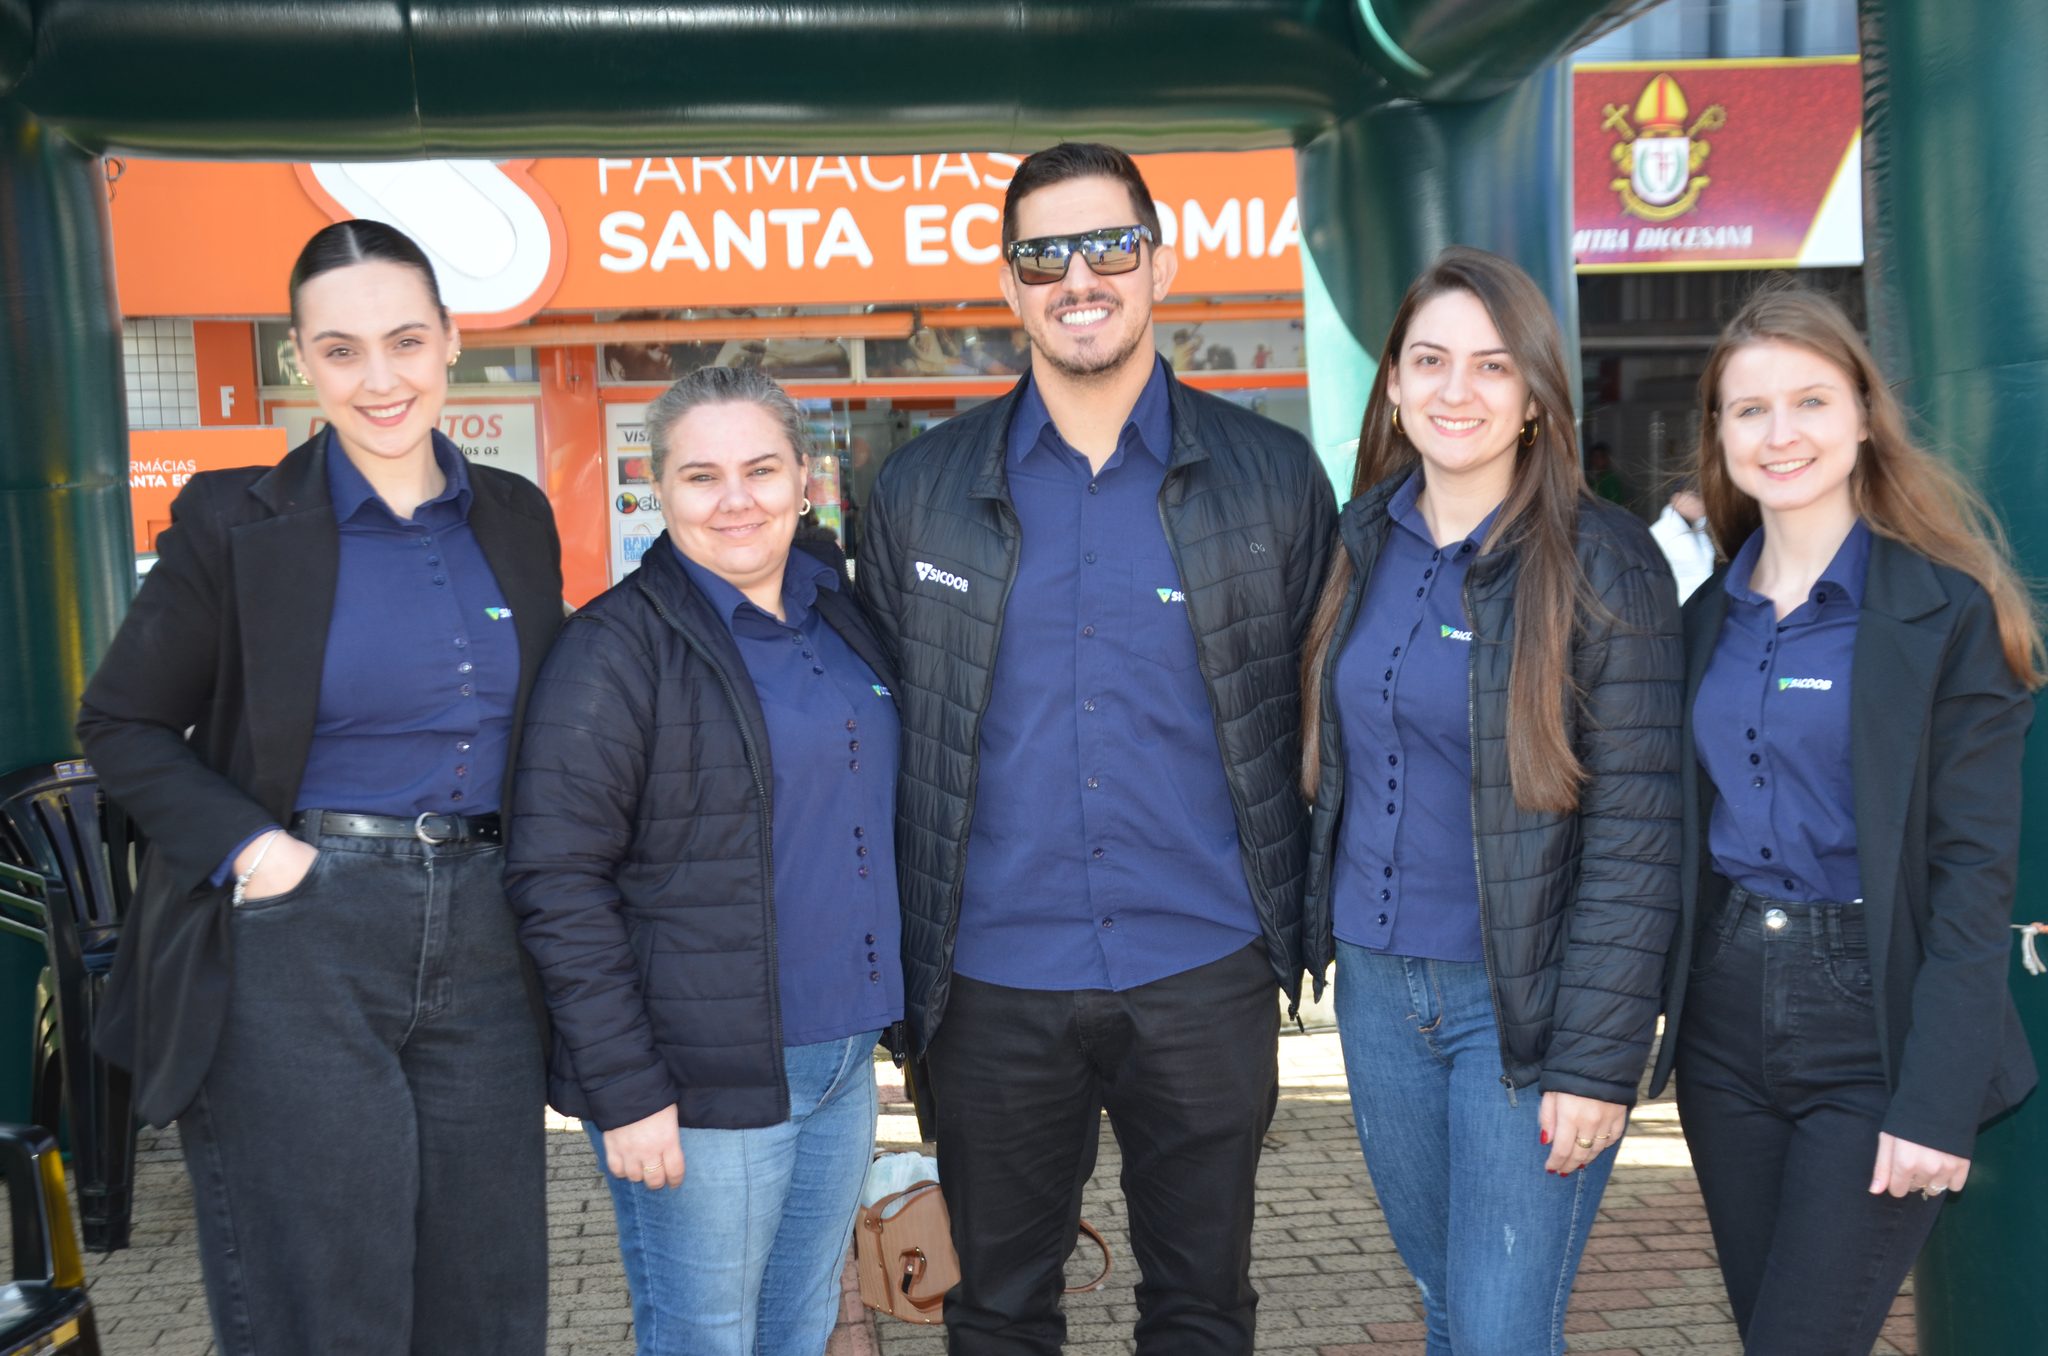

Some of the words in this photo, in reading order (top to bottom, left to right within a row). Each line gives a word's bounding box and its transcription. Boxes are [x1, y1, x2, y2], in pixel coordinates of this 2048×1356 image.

[599, 207, 873, 273] SANTA
[1633, 225, 1753, 251] DIOCESANA
[927, 568, 969, 593] SICOOB
[1788, 678, 1833, 691] SICOOB
